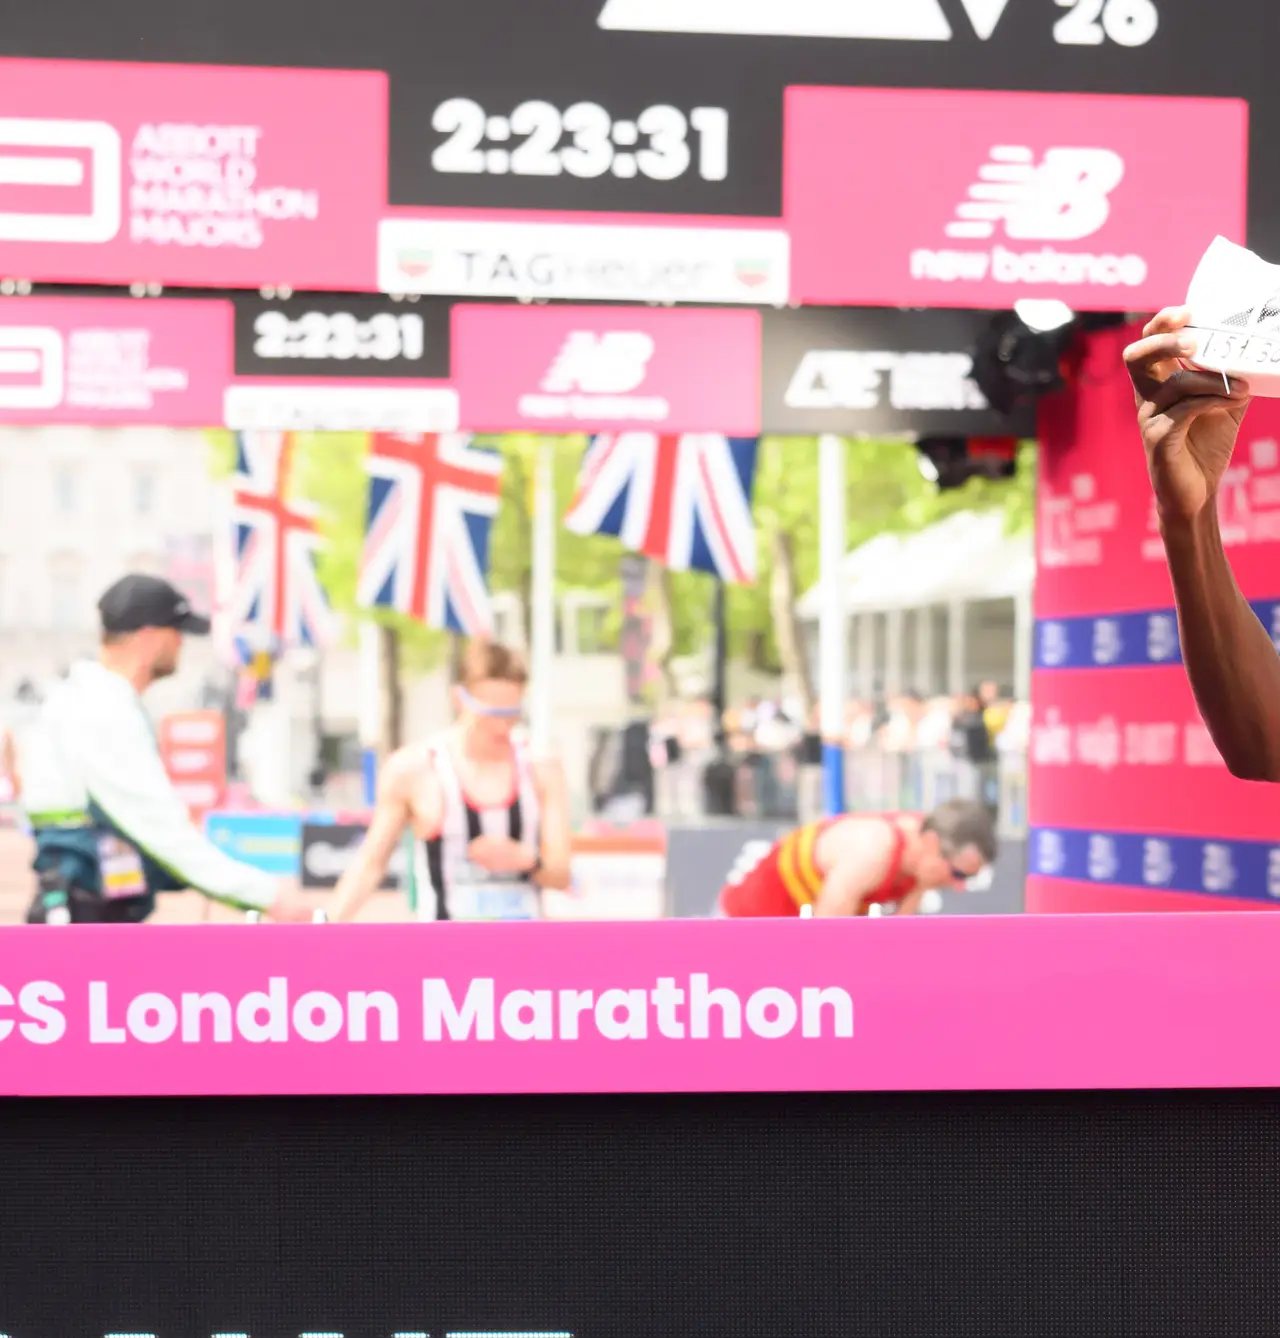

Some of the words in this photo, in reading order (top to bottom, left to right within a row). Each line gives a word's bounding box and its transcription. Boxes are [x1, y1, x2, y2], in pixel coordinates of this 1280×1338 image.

[432, 98, 729, 180] 2:23:31
[254, 311, 424, 360] 2:23:31
[88, 976, 399, 1044] London
[422, 972, 854, 1041] Marathon
